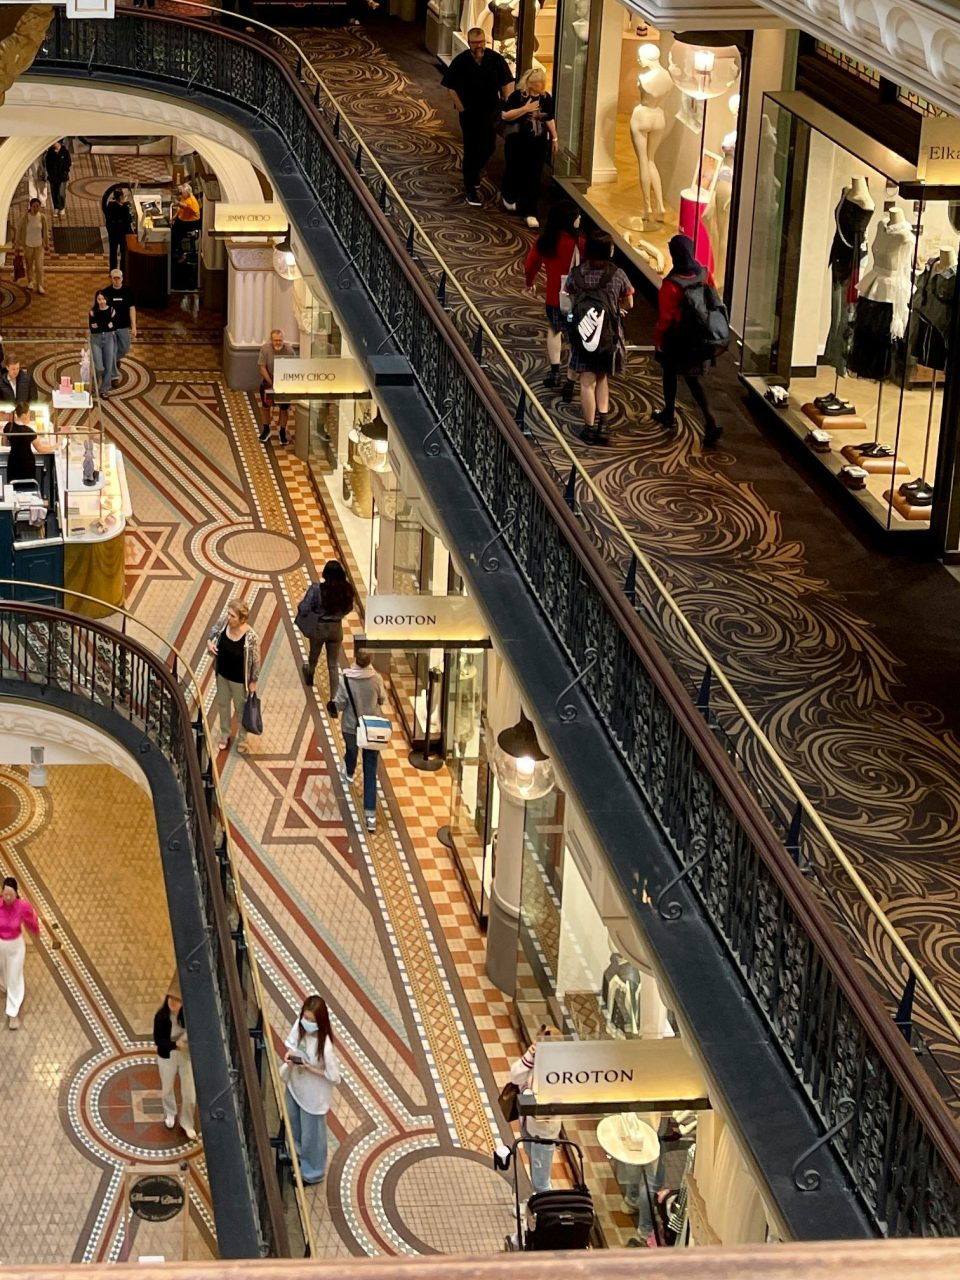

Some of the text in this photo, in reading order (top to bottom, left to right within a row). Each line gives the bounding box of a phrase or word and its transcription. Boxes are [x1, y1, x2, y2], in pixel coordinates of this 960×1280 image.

[578, 307, 599, 342] NIKE
[280, 373, 336, 382] JIMMY CHOO
[373, 615, 437, 625] OROTON
[545, 1069, 634, 1085] OROTON
